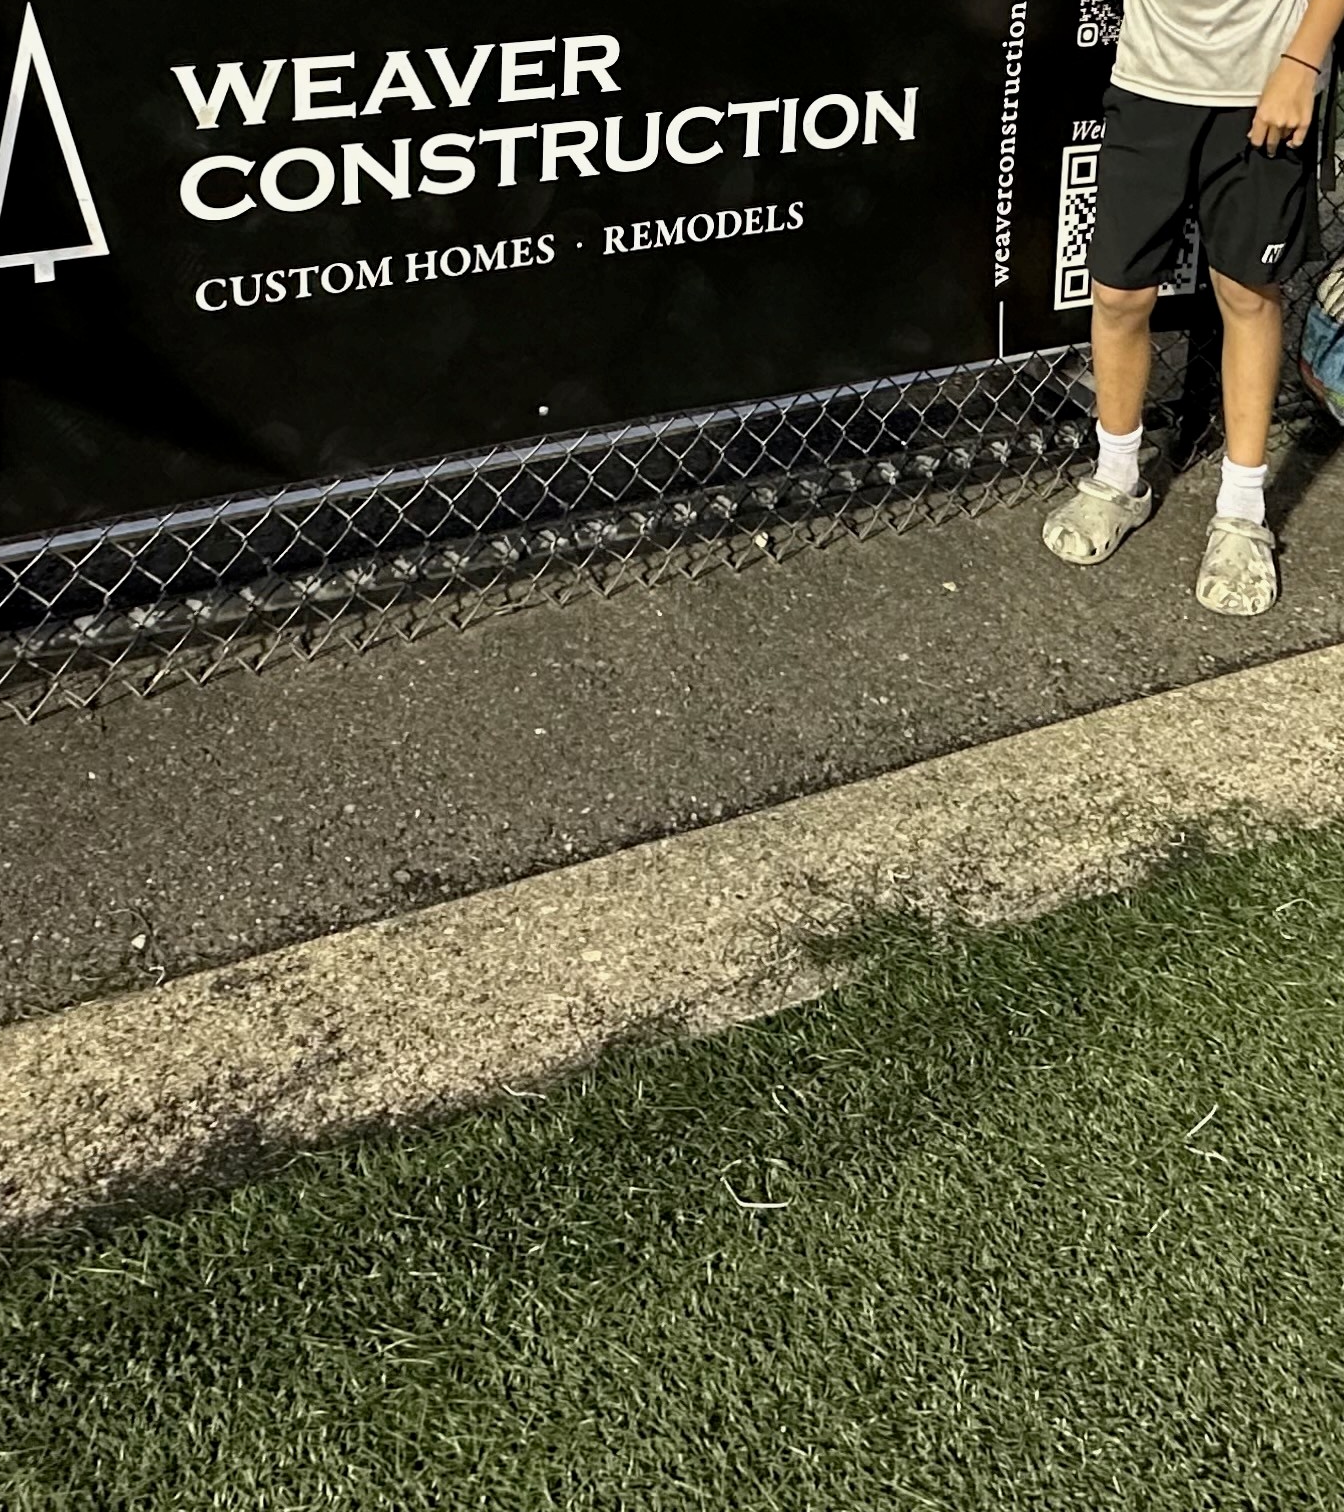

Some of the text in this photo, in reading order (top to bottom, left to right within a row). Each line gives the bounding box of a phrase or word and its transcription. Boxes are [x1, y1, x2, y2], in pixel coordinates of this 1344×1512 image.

[171, 35, 622, 130] WEAVER
[180, 87, 919, 221] CONSTRUCTION
[196, 201, 804, 312] CUSTOM HOMES REMODELS
